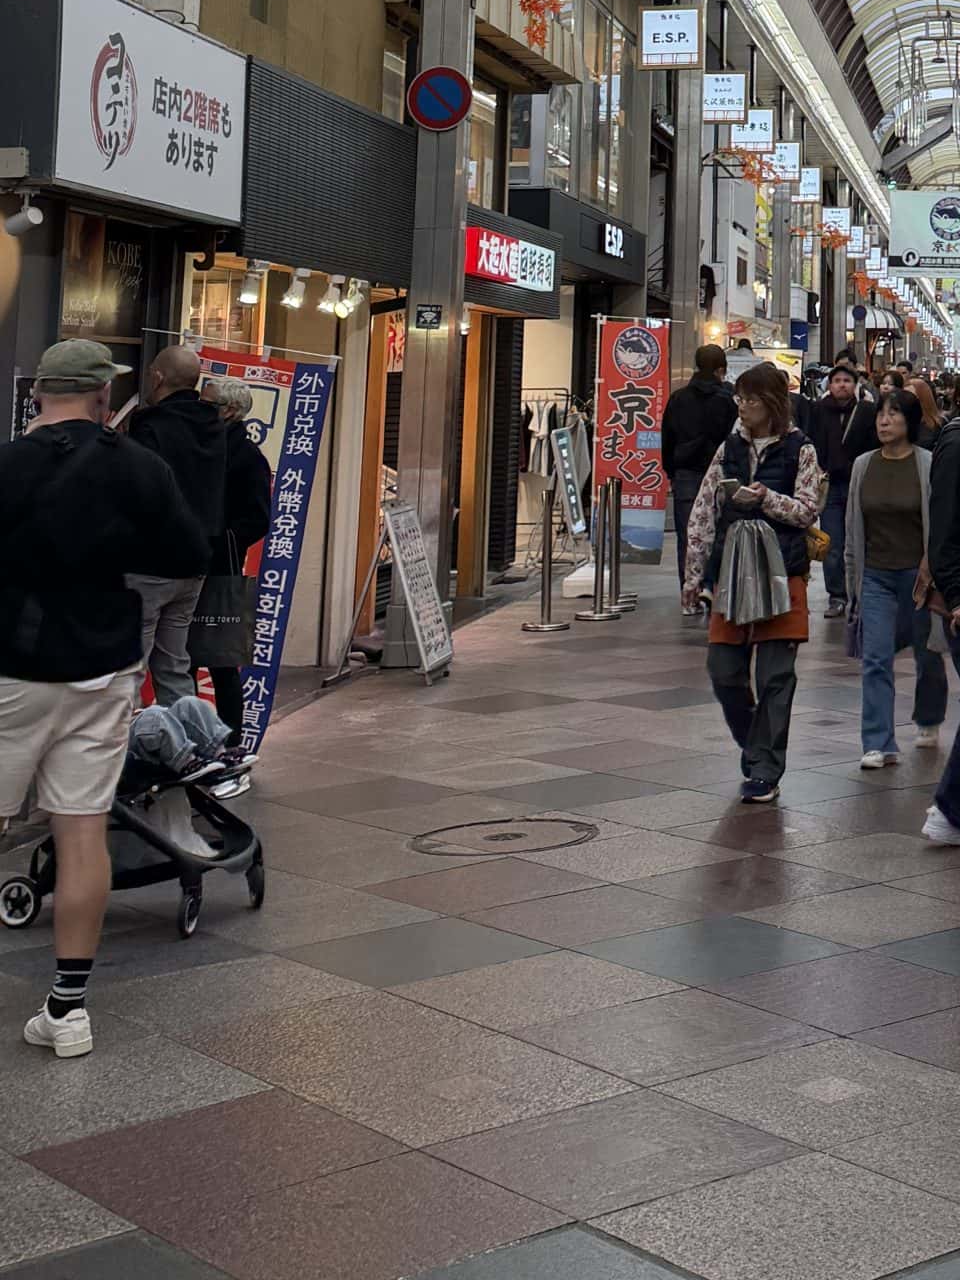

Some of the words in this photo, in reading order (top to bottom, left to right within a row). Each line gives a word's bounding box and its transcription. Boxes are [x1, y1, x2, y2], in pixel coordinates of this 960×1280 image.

[652, 31, 689, 44] E.S.P.
[152, 76, 232, 139] 店内2階席も
[165, 128, 219, 176] あります
[253, 569, 288, 668] 외화환전
